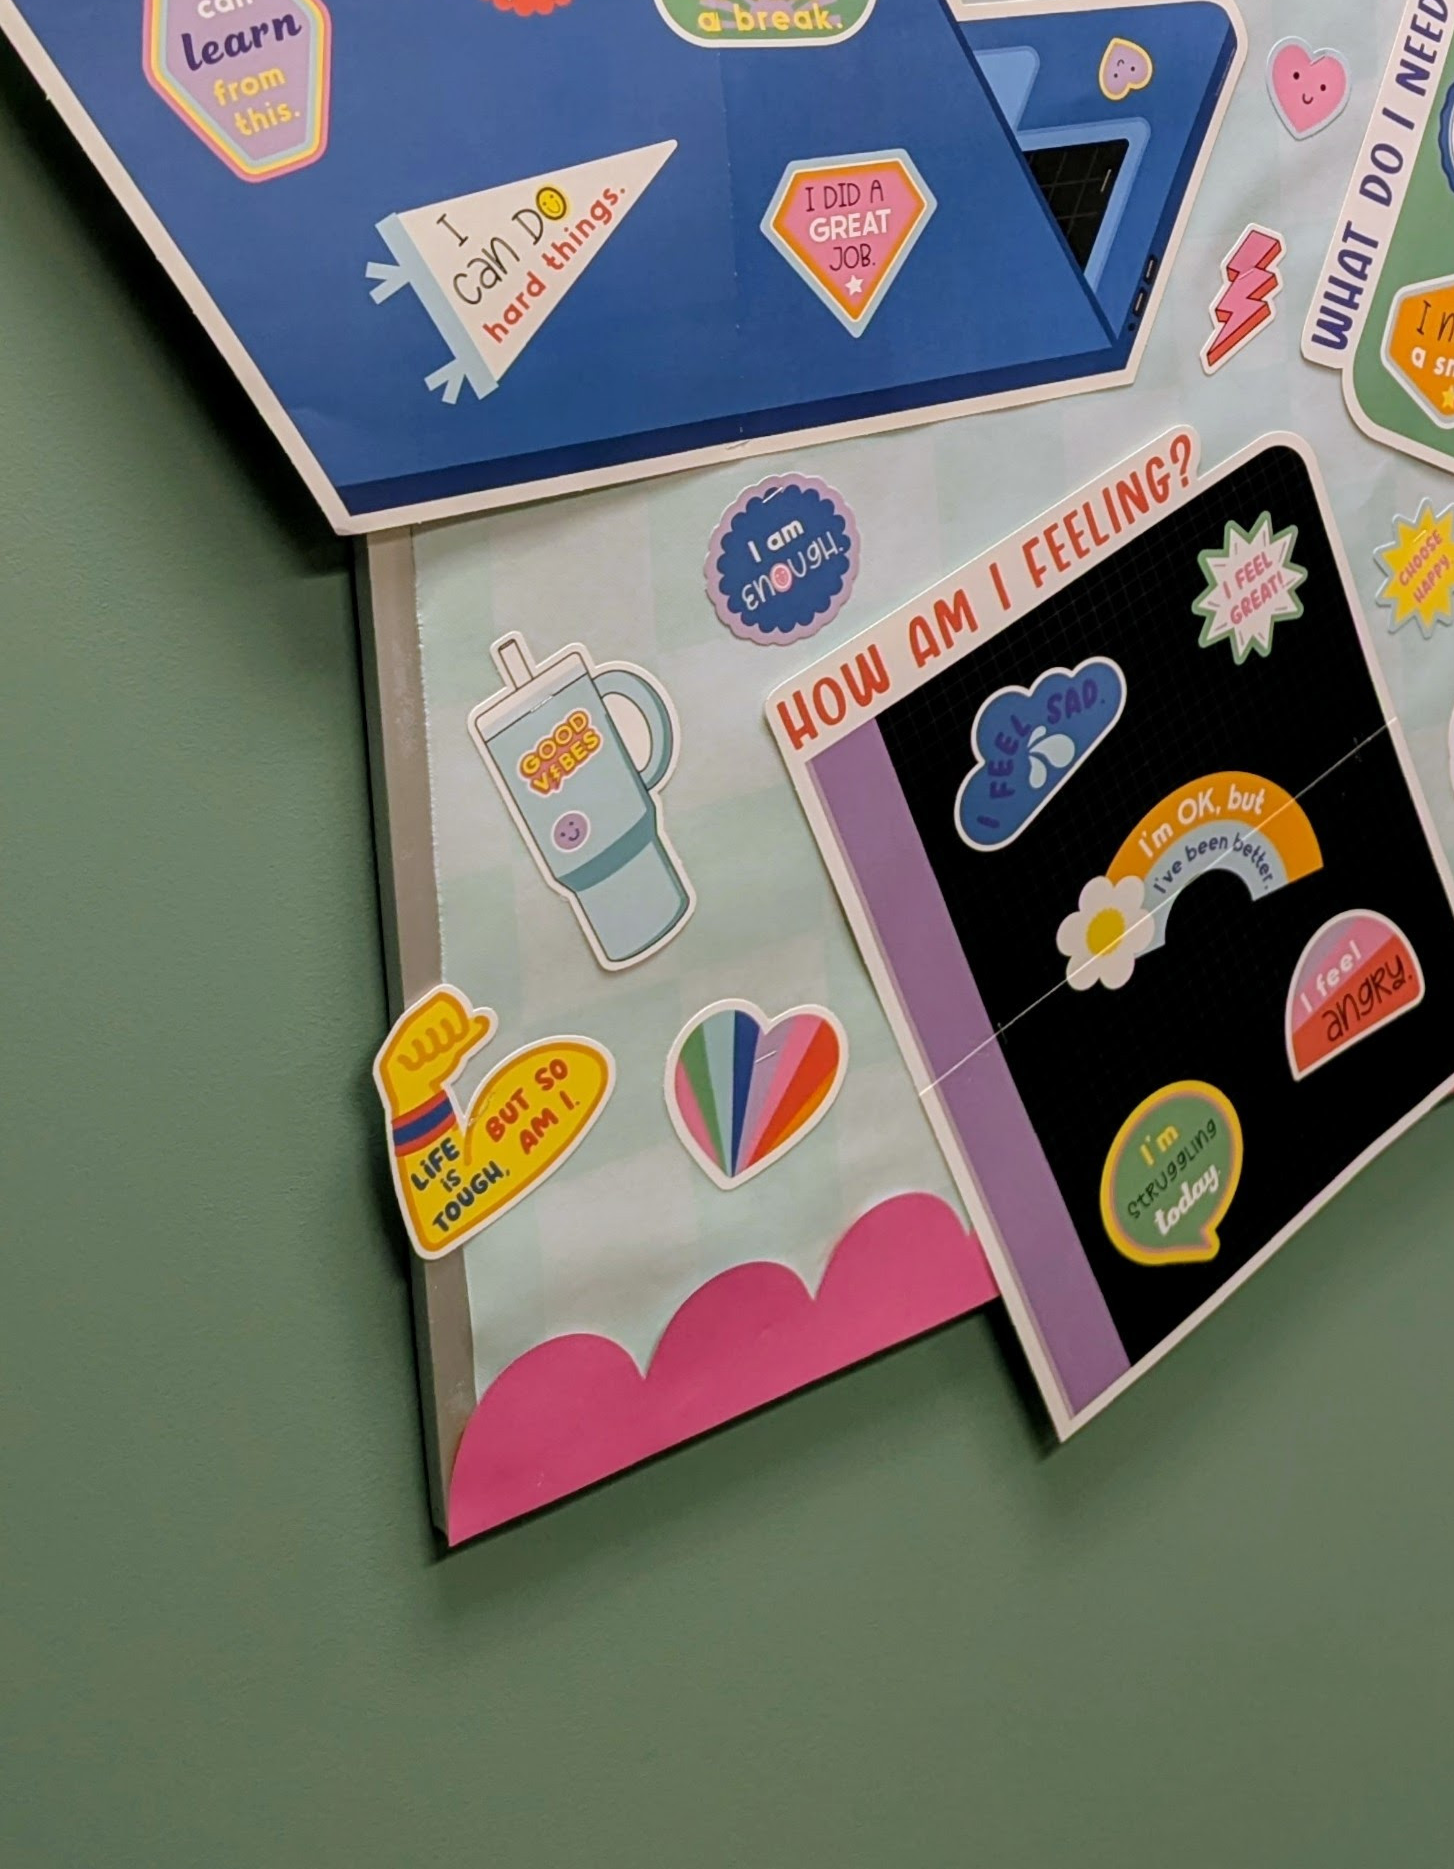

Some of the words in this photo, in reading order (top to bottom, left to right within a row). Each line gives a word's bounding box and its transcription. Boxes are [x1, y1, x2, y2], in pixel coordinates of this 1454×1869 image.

[698, 12, 722, 32] a
[737, 4, 844, 32] break.
[181, 13, 302, 72] learn
[212, 68, 286, 107] from
[234, 102, 300, 136] this.
[804, 186, 815, 212] I
[824, 182, 861, 210] DID
[870, 179, 884, 204] A
[436, 213, 469, 247] I
[809, 208, 892, 243] GREAT
[1311, 220, 1379, 351] WHAT
[1359, 143, 1404, 207] DO
[1382, 107, 1415, 131] I
[482, 271, 547, 344] hard
[541, 187, 626, 271] things.
[829, 243, 876, 271] JOB.
[1416, 300, 1432, 336] I
[1411, 346, 1427, 369] a
[747, 540, 762, 563] I
[766, 520, 805, 551] am
[1399, 529, 1442, 586] CHOOSE
[776, 643, 892, 750] HOW
[908, 588, 979, 668] AM
[989, 562, 1013, 611] I
[1021, 433, 1193, 589] FEELING?
[1223, 580, 1231, 600] I
[1234, 551, 1273, 590] FEEL
[1230, 570, 1285, 625] GREAT!
[521, 712, 588, 776] GOOD
[987, 714, 1032, 800] FEEL
[977, 815, 1001, 829] I
[1137, 822, 1174, 858] I'm
[1177, 787, 1221, 825] OK,
[1227, 783, 1266, 816] but
[1153, 860, 1183, 894] I've
[1185, 835, 1228, 862] been
[1232, 832, 1274, 890] better.
[1300, 992, 1313, 1013] I
[1316, 939, 1362, 997] feel
[485, 1087, 529, 1143] BUT
[535, 1058, 568, 1091] SO
[519, 1107, 559, 1155] AM
[1140, 1125, 1179, 1166] I'm
